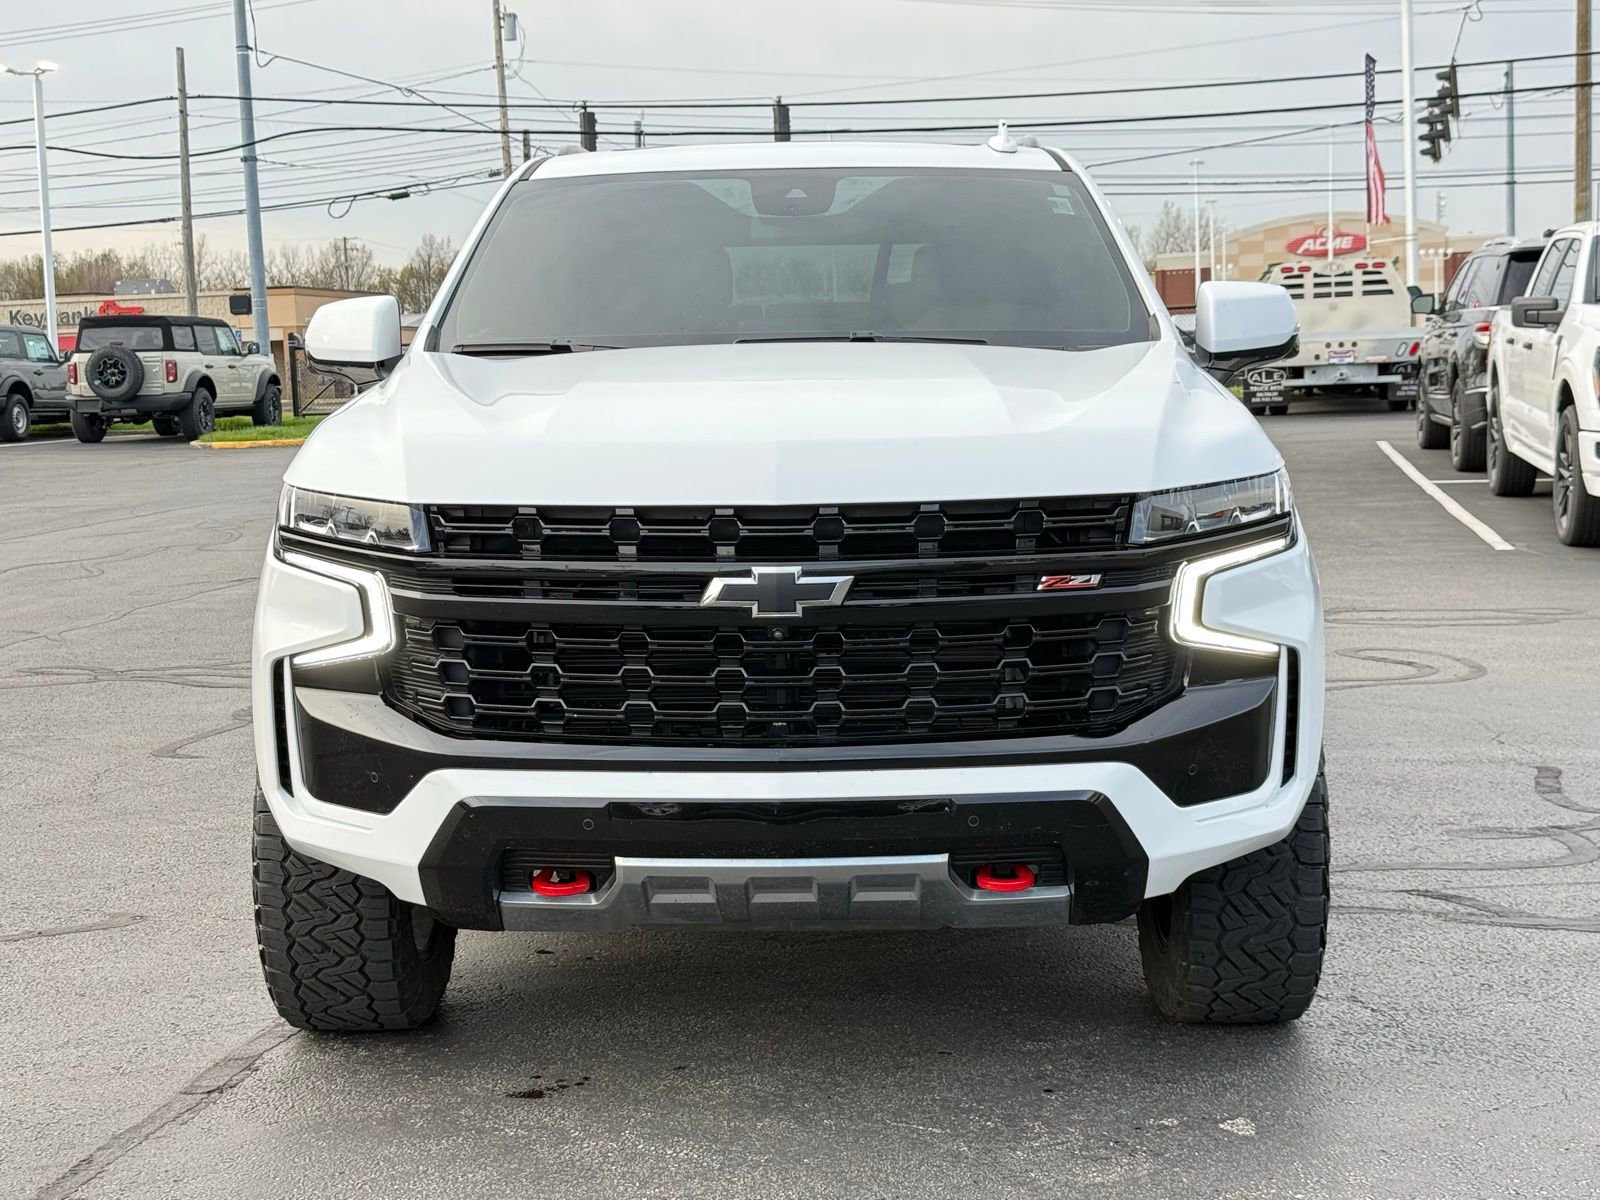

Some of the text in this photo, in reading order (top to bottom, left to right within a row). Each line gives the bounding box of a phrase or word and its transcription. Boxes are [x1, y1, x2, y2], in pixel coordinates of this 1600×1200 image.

[1296, 236, 1354, 254] ACME
[9, 305, 96, 328] Keyank
[1036, 574, 1102, 590] Z71
